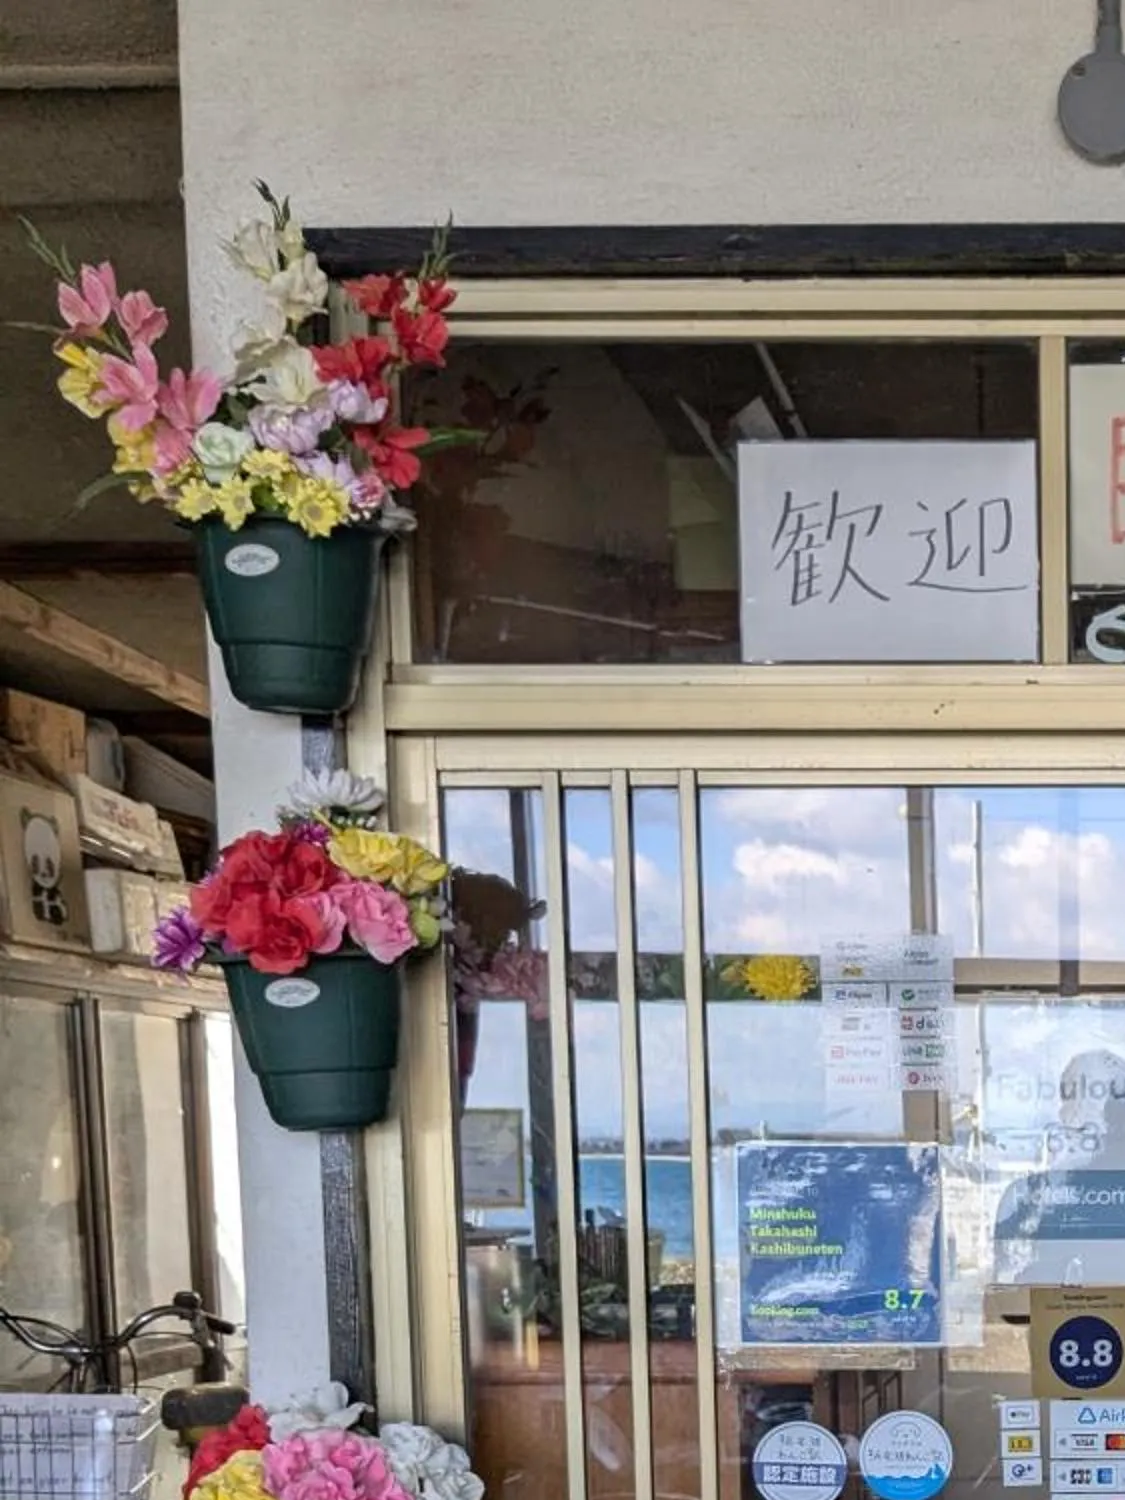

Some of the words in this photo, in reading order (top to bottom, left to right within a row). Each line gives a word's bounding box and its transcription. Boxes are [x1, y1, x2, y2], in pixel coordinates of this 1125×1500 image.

[771, 489, 1028, 606] 歓迎
[750, 1225, 818, 1238] Takahashi
[883, 1289, 924, 1310] 8.7
[1059, 1339, 1113, 1367] 8.8
[762, 1464, 838, 1485] 認定施設
